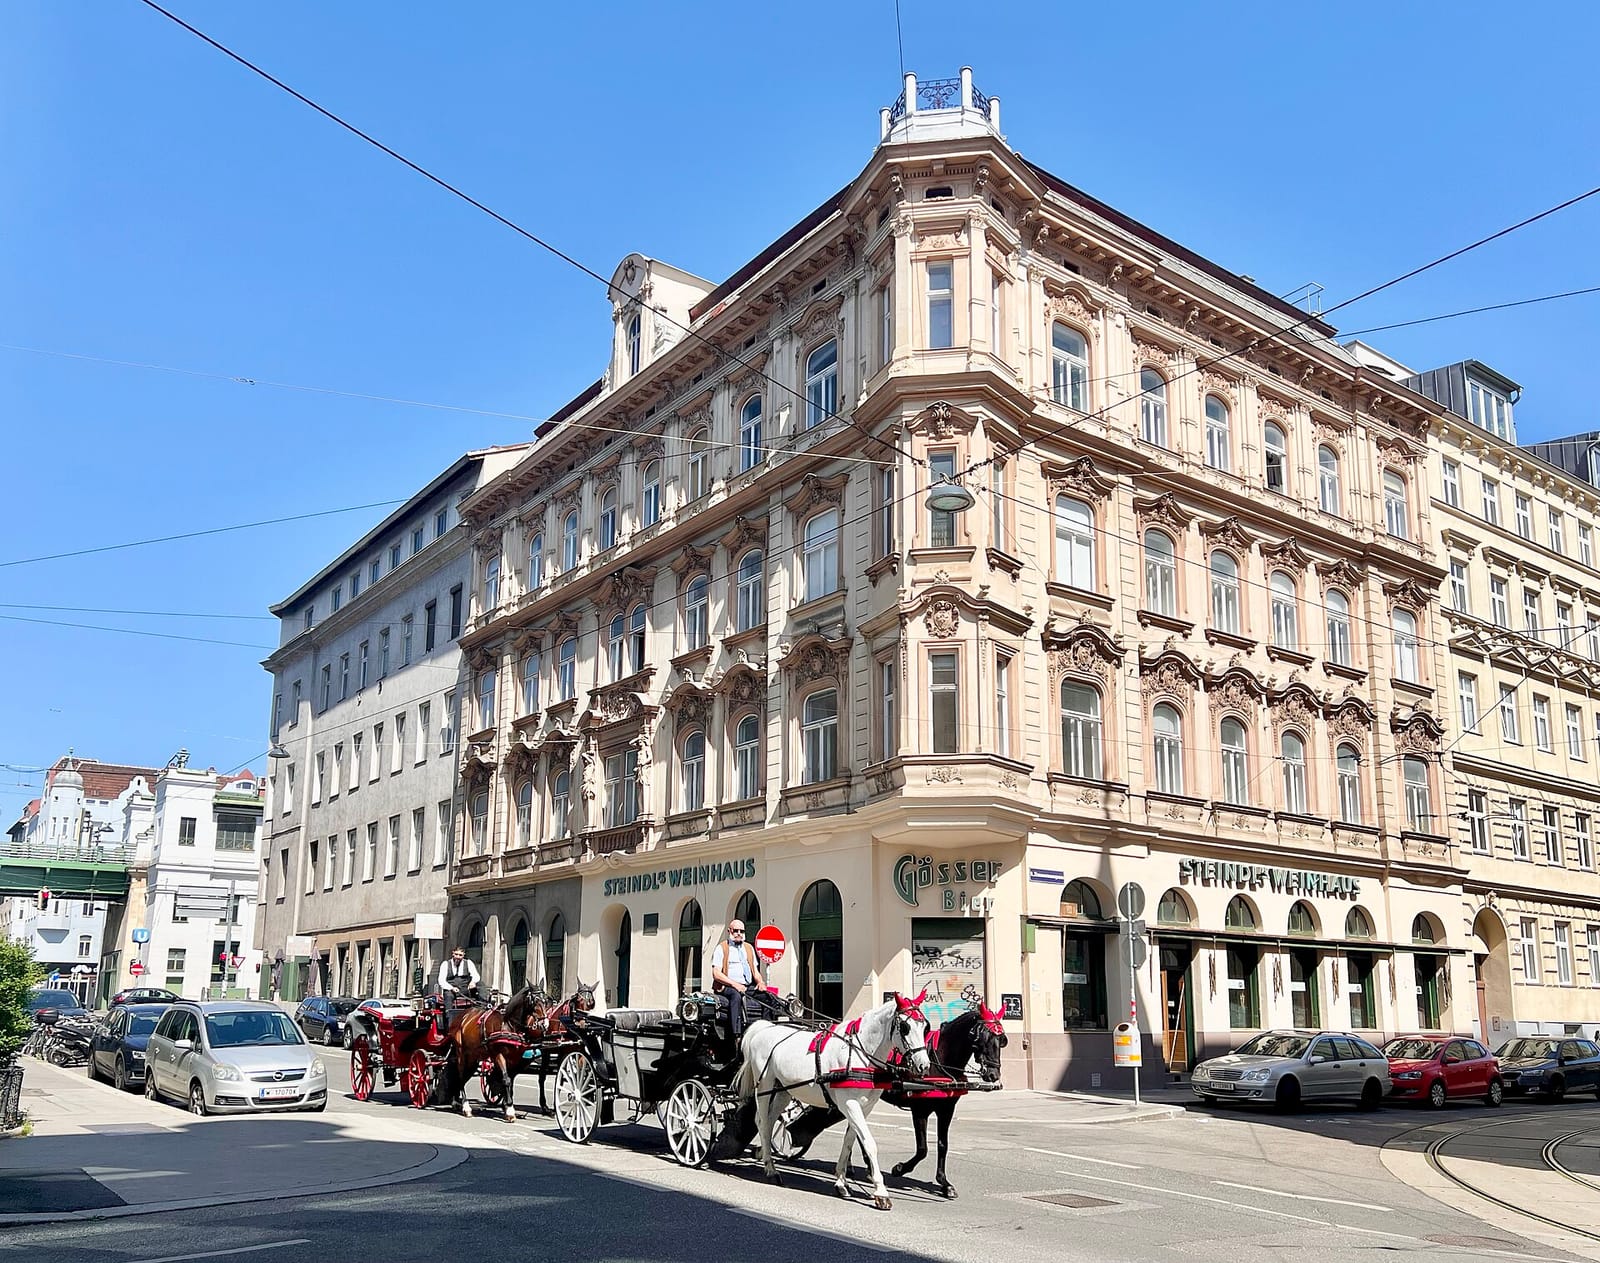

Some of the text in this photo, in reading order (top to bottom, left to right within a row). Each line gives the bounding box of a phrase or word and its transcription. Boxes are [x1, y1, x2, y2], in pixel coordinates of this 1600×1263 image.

[668, 858, 756, 888] WEINHAUS
[892, 854, 1003, 906] Gösser
[1269, 868, 1361, 895] WEINHAUS
[942, 889, 996, 912] Bier
